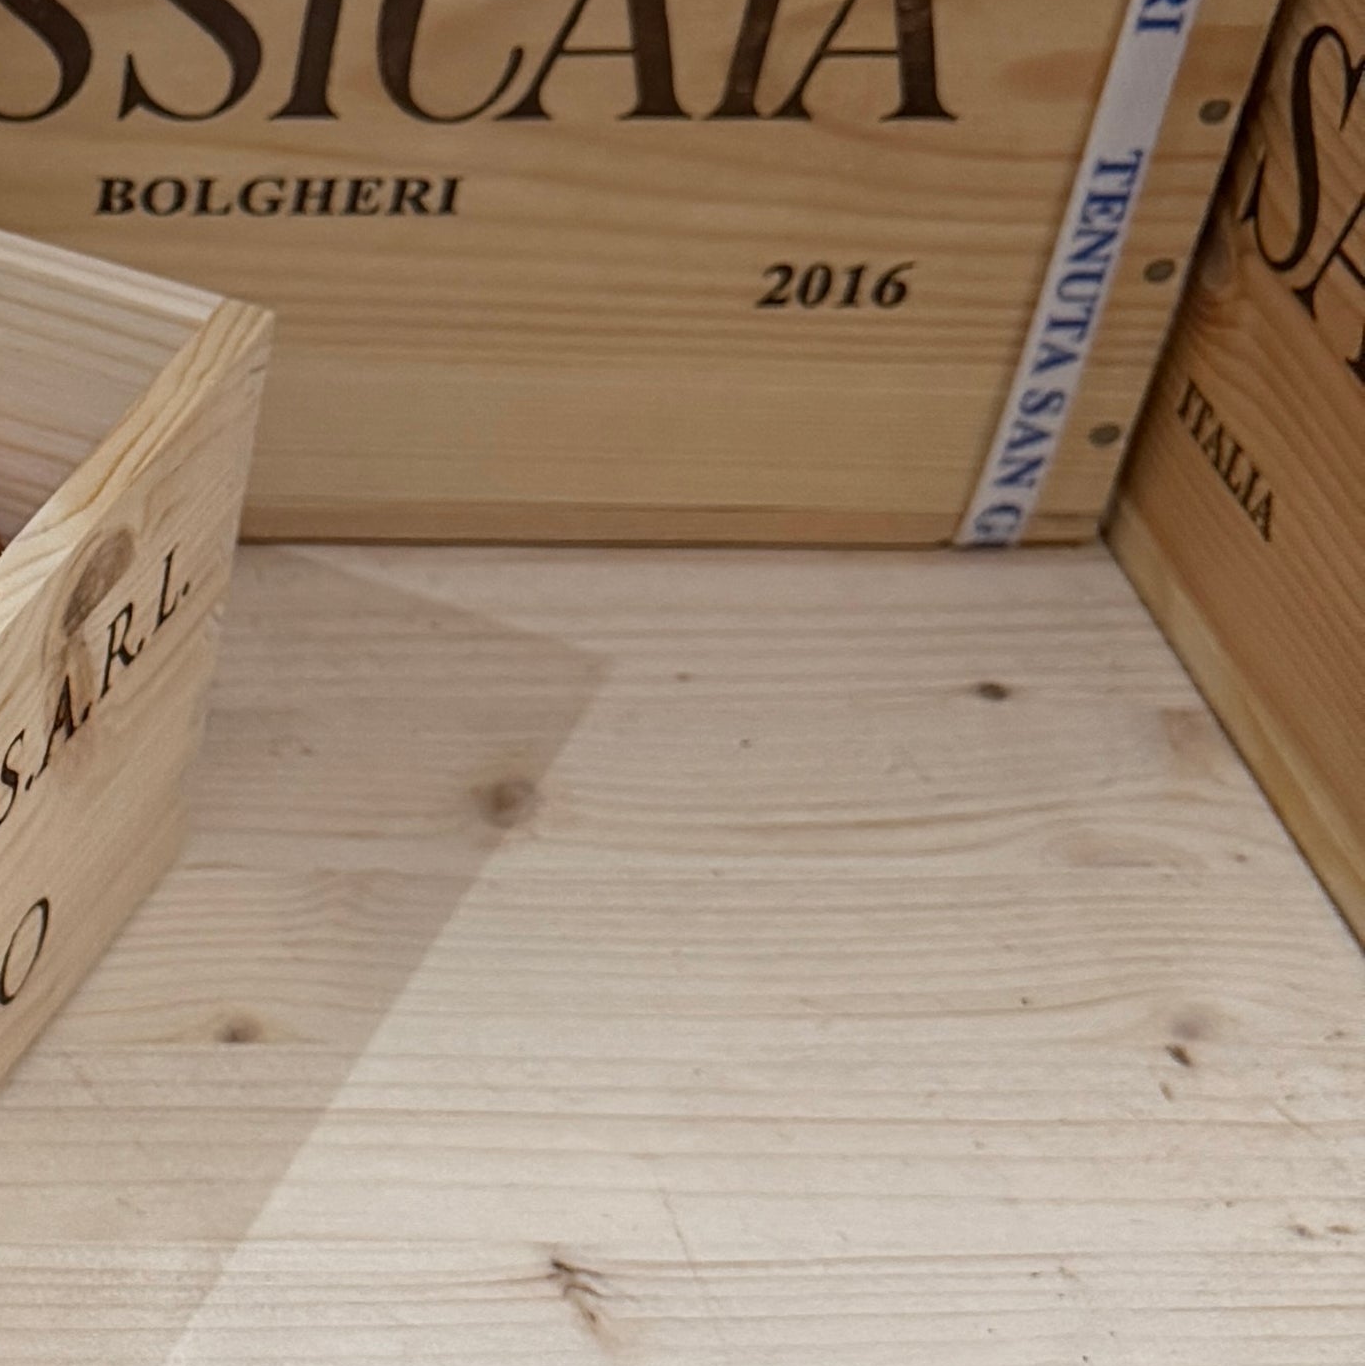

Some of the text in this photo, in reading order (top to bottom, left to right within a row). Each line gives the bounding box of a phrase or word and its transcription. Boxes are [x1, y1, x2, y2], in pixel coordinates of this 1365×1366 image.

[94, 176, 464, 218] BOLGHERI
[756, 262, 915, 309] 2016
[1029, 149, 1144, 377] TENUTA
[993, 387, 1066, 488] SAN
[1177, 378, 1276, 544] ITALIA
